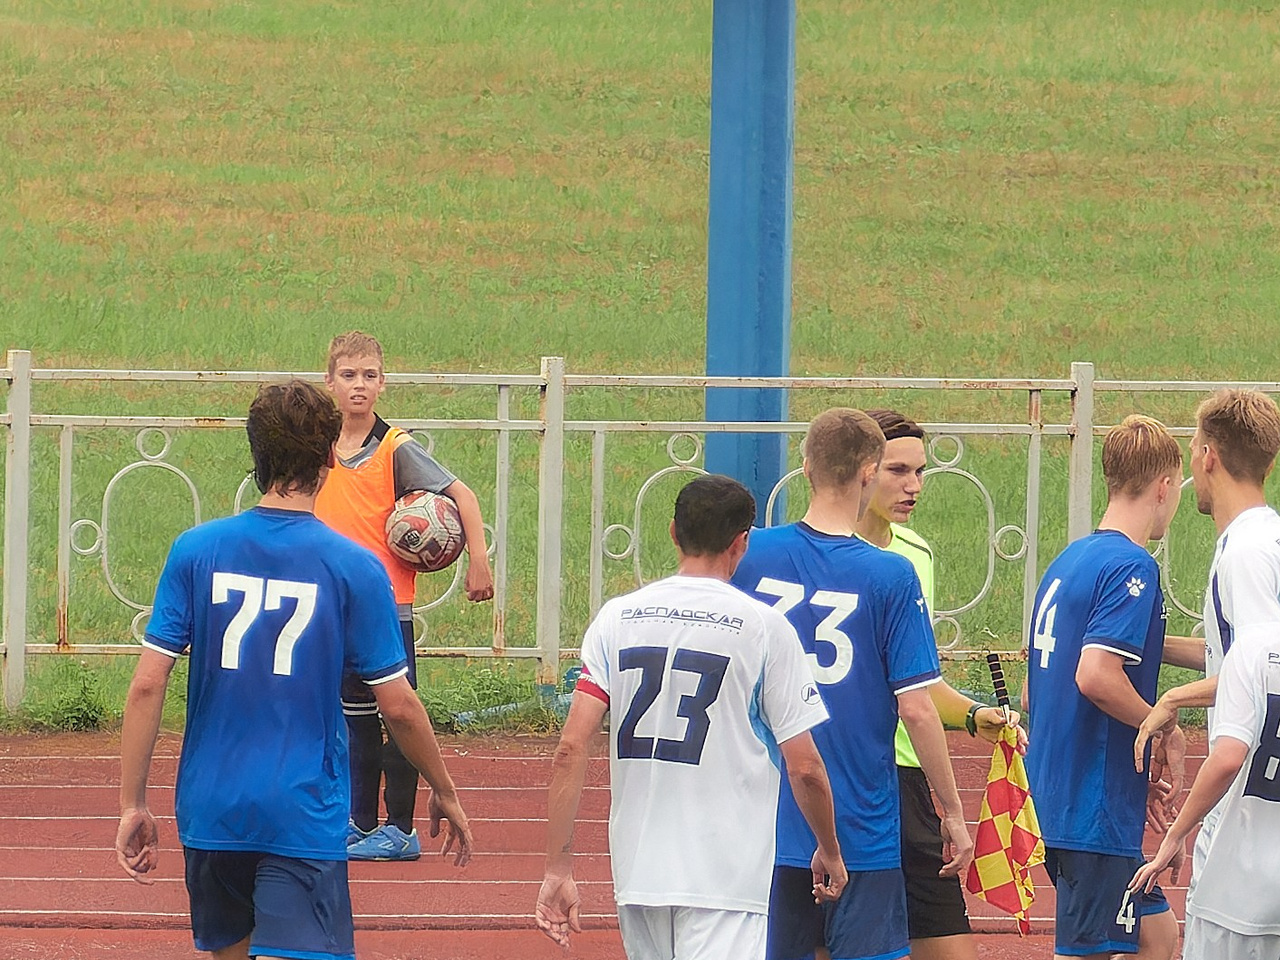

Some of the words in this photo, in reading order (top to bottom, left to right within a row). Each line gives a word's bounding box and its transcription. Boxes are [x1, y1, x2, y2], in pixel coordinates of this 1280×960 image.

[212, 572, 318, 676] 77
[1034, 578, 1062, 668] 4
[617, 645, 731, 766] 23
[1115, 888, 1136, 934] 4
